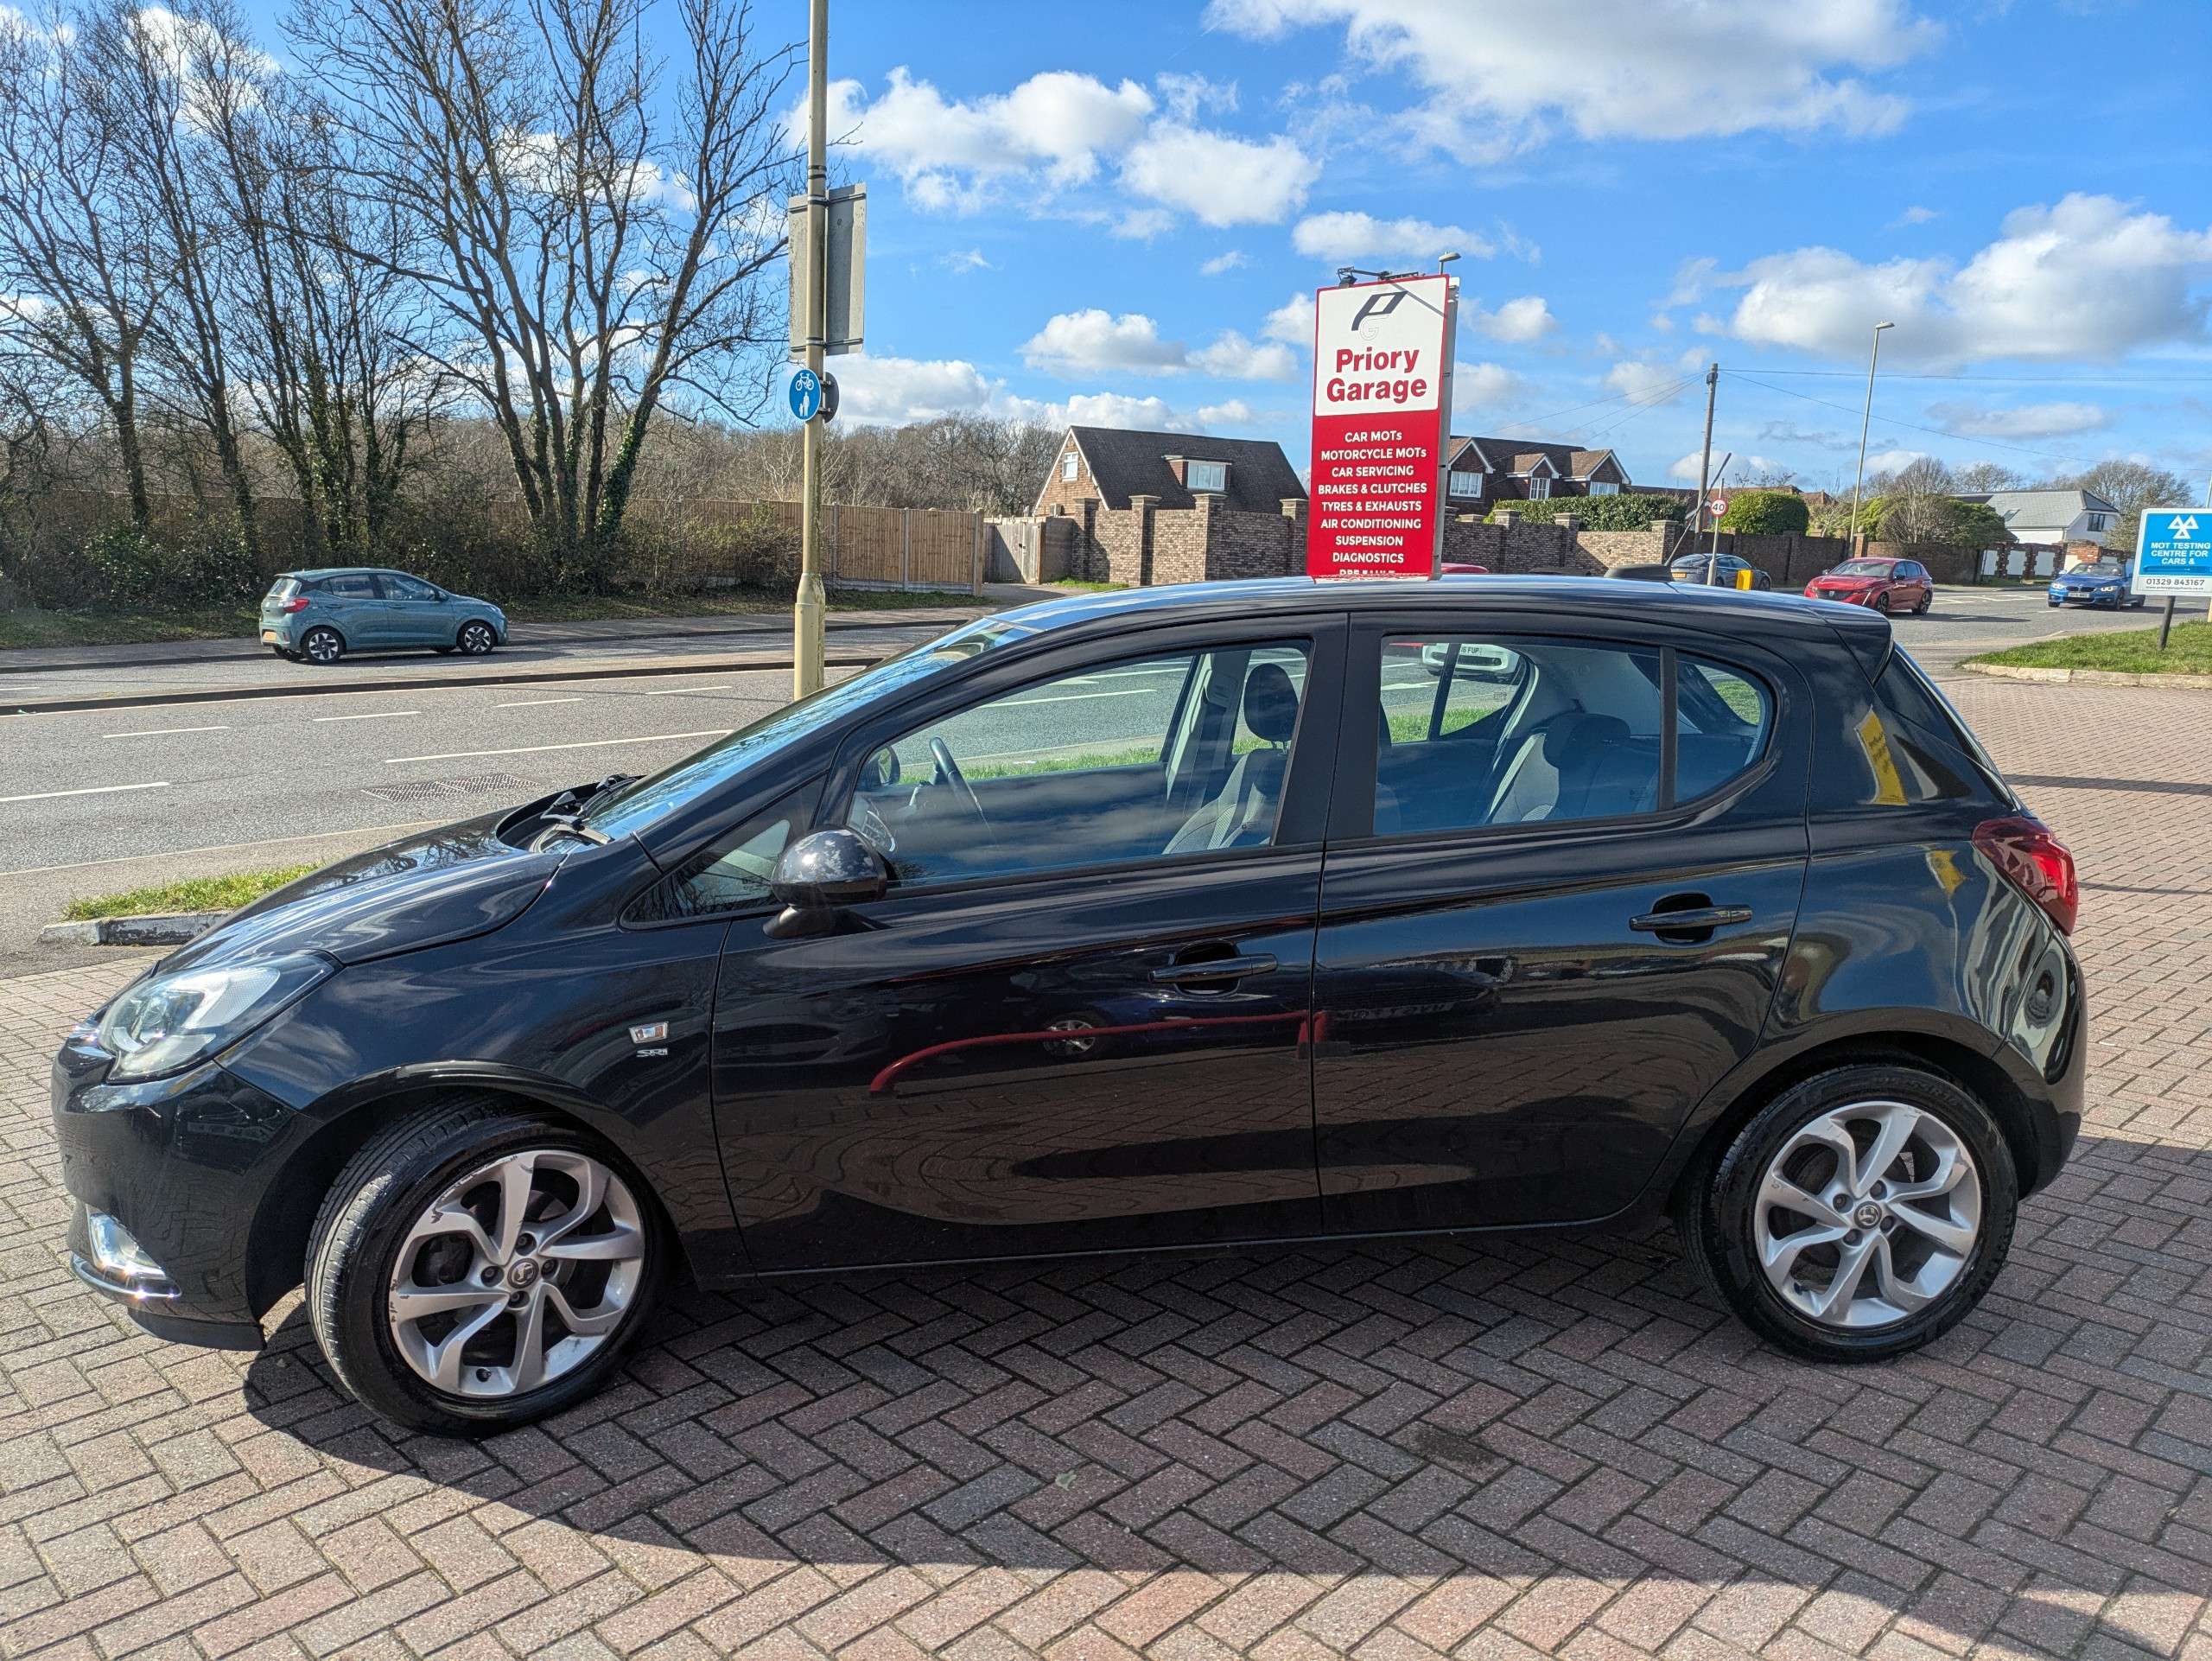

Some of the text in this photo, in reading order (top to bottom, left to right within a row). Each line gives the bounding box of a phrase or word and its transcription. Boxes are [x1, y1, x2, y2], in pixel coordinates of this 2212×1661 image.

[1336, 347, 1420, 373] Priory
[1326, 378, 1427, 404] Garage
[1344, 430, 1402, 442] CAR MOTs
[1321, 448, 1427, 461] MOTORCYCLE MOTs
[1332, 466, 1414, 477] CAR SERVICING
[1318, 483, 1427, 494] BRAKES & CLUTCHES
[1322, 501, 1422, 512] TYRES & EXHAUSTS
[1320, 519, 1421, 529] AIR CONDITIONING
[1335, 536, 1403, 546] SUSPENSION
[1332, 552, 1404, 563] DIAGNOSTICS
